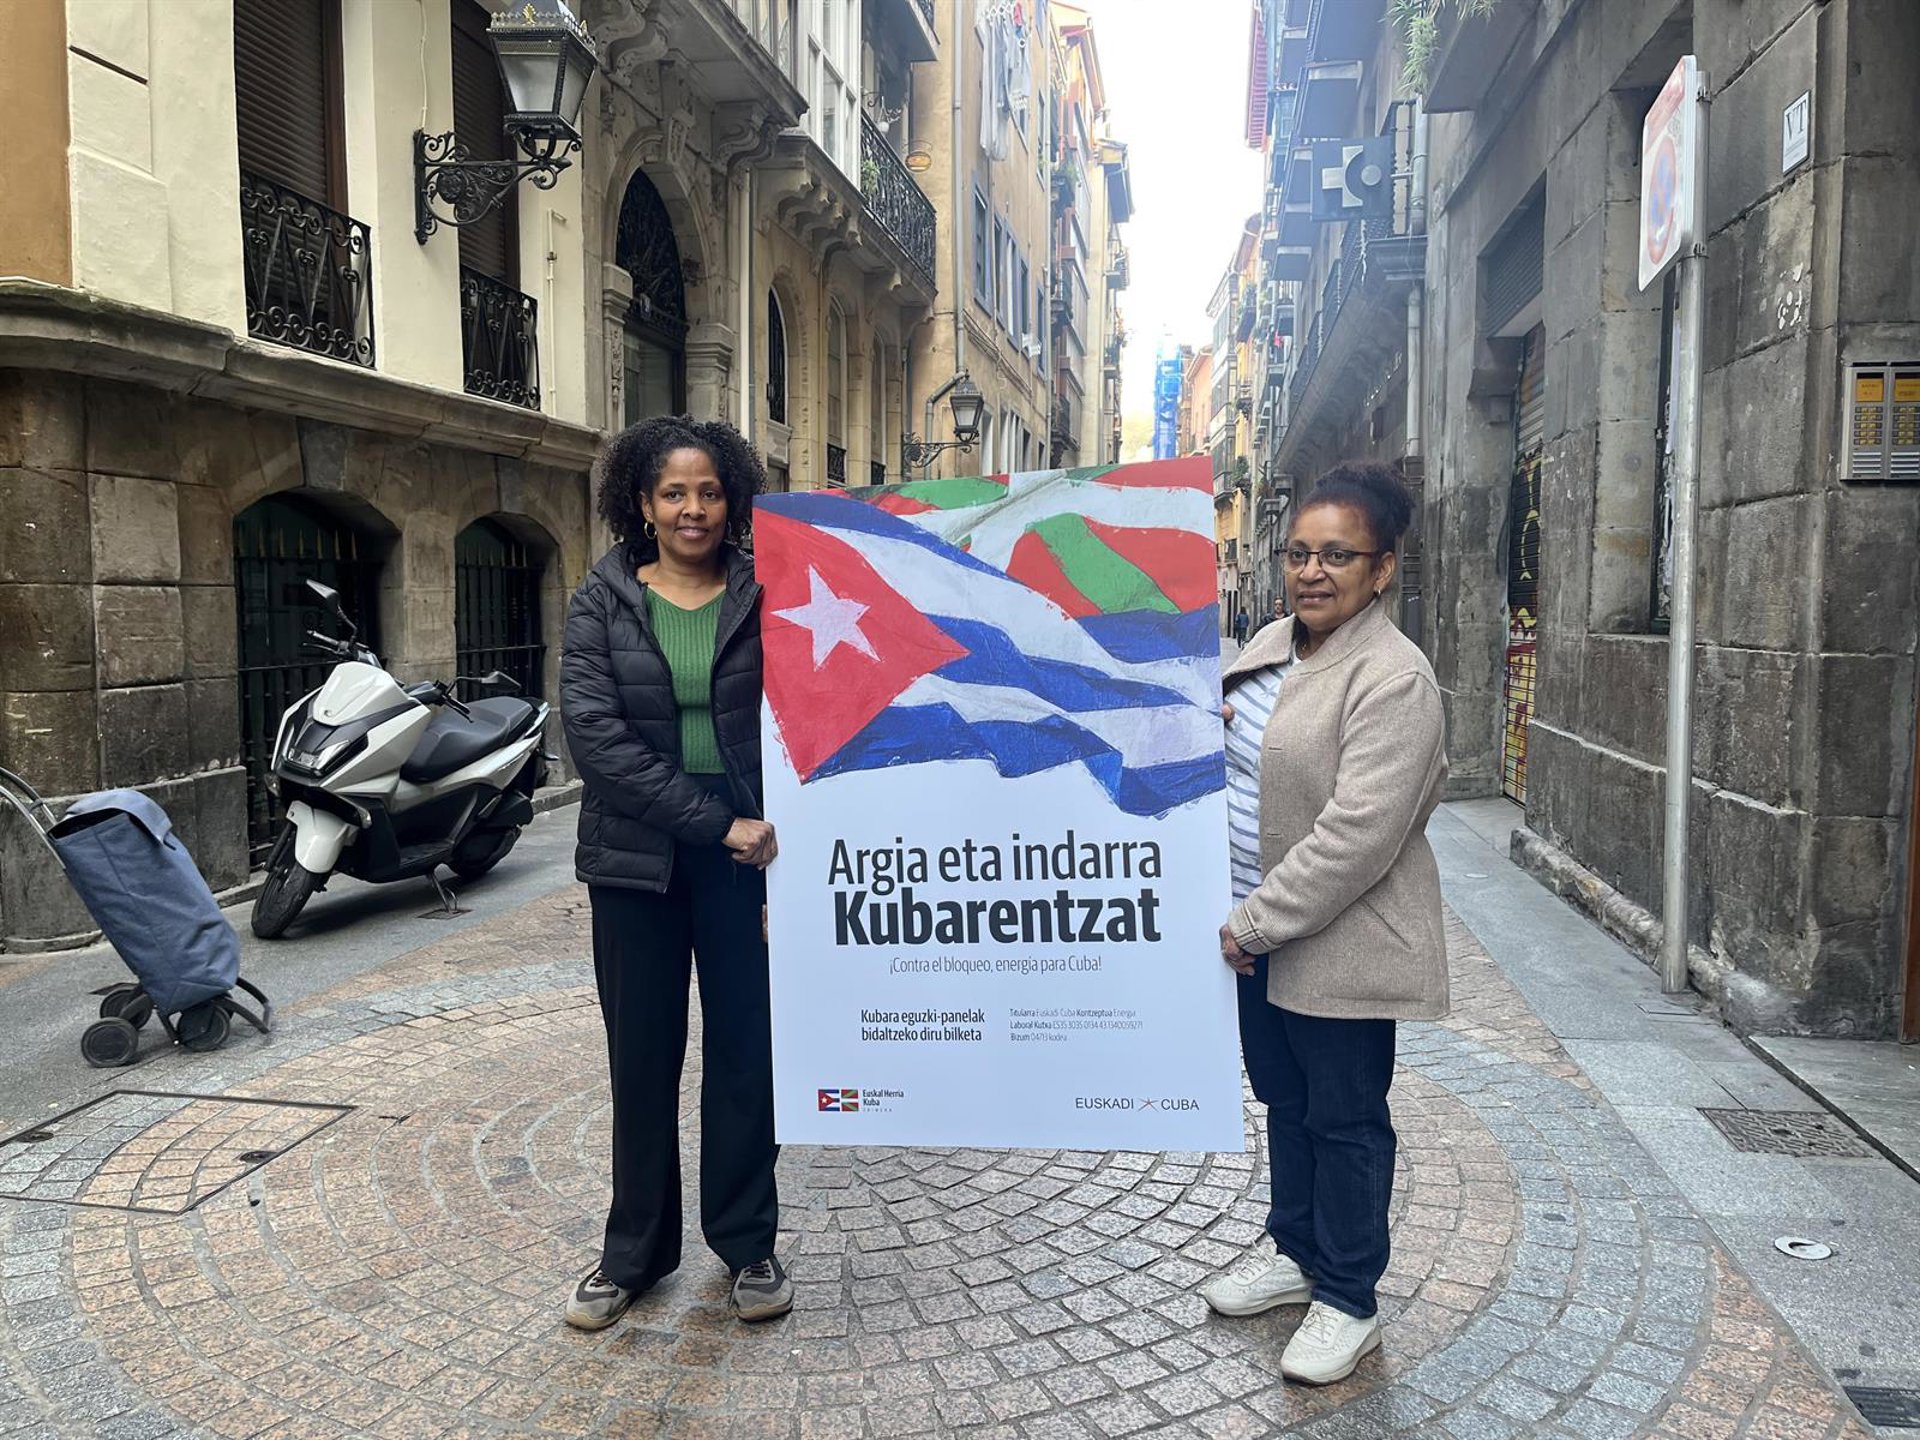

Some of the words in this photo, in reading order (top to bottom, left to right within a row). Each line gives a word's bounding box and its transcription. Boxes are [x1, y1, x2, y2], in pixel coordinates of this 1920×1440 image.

[828, 837, 928, 895] Argia
[939, 838, 1001, 882] eta
[1012, 829, 1162, 881] indarra
[834, 887, 1162, 945] Kubarentzat
[889, 956, 929, 974] ¡Contra
[932, 956, 942, 972] el
[944, 956, 993, 974] bloqueo,
[1041, 958, 1066, 974] para
[1068, 954, 1102, 972] Cuba!
[861, 1009, 899, 1023] Kubara
[901, 1008, 985, 1026] eguzki-panelak
[862, 1027, 918, 1041] bidaltzeko
[920, 1027, 941, 1041] diru
[944, 1026, 981, 1041] bilketa
[863, 1089, 883, 1098] Euskal
[863, 1098, 880, 1106] Kuba
[1075, 1098, 1134, 1109] EUSKADI
[1161, 1099, 1200, 1110] CUBA
